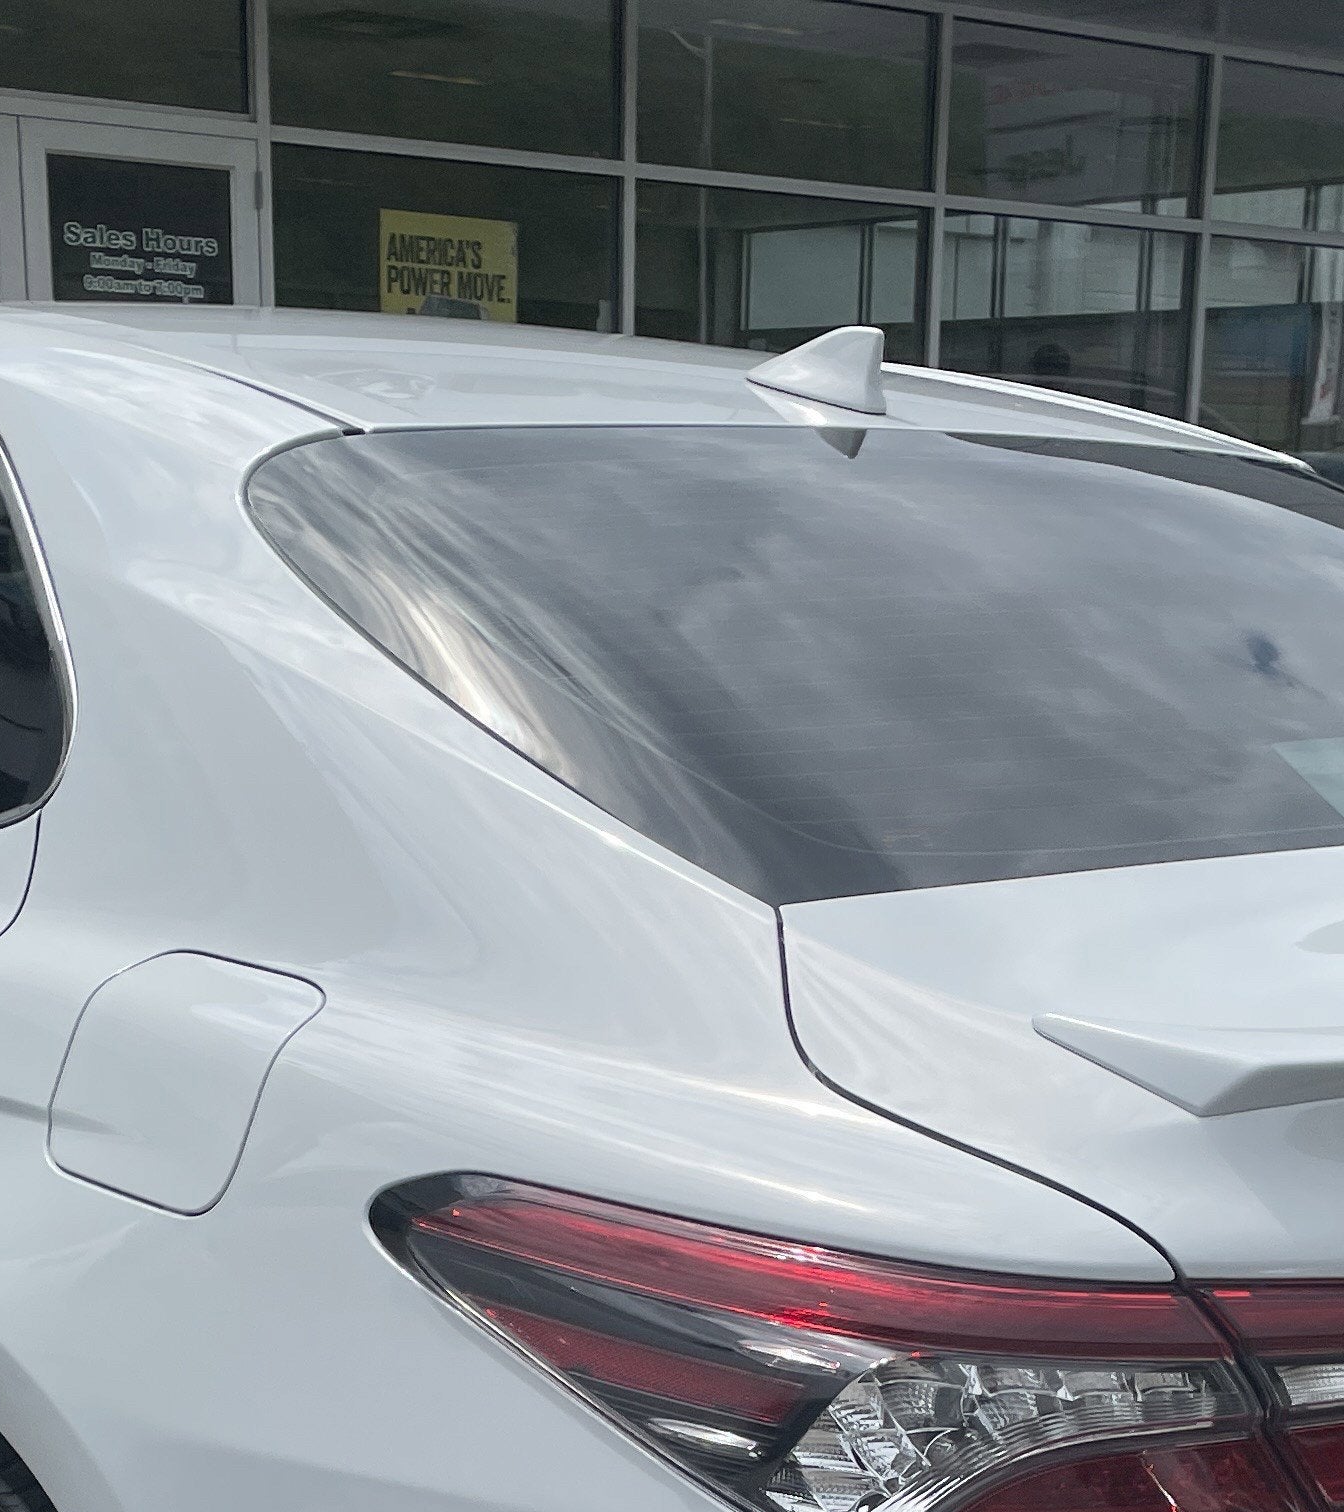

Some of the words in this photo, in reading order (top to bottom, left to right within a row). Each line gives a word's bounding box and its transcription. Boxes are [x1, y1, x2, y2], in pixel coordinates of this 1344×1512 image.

[63, 222, 136, 250] Sales
[142, 227, 219, 256] Hours
[387, 232, 483, 270] AMERICA'S
[90, 252, 144, 275] Monday
[154, 257, 196, 278] Friday
[137, 279, 153, 295] to
[387, 264, 452, 298] POWER
[457, 271, 511, 304] MOVE.
